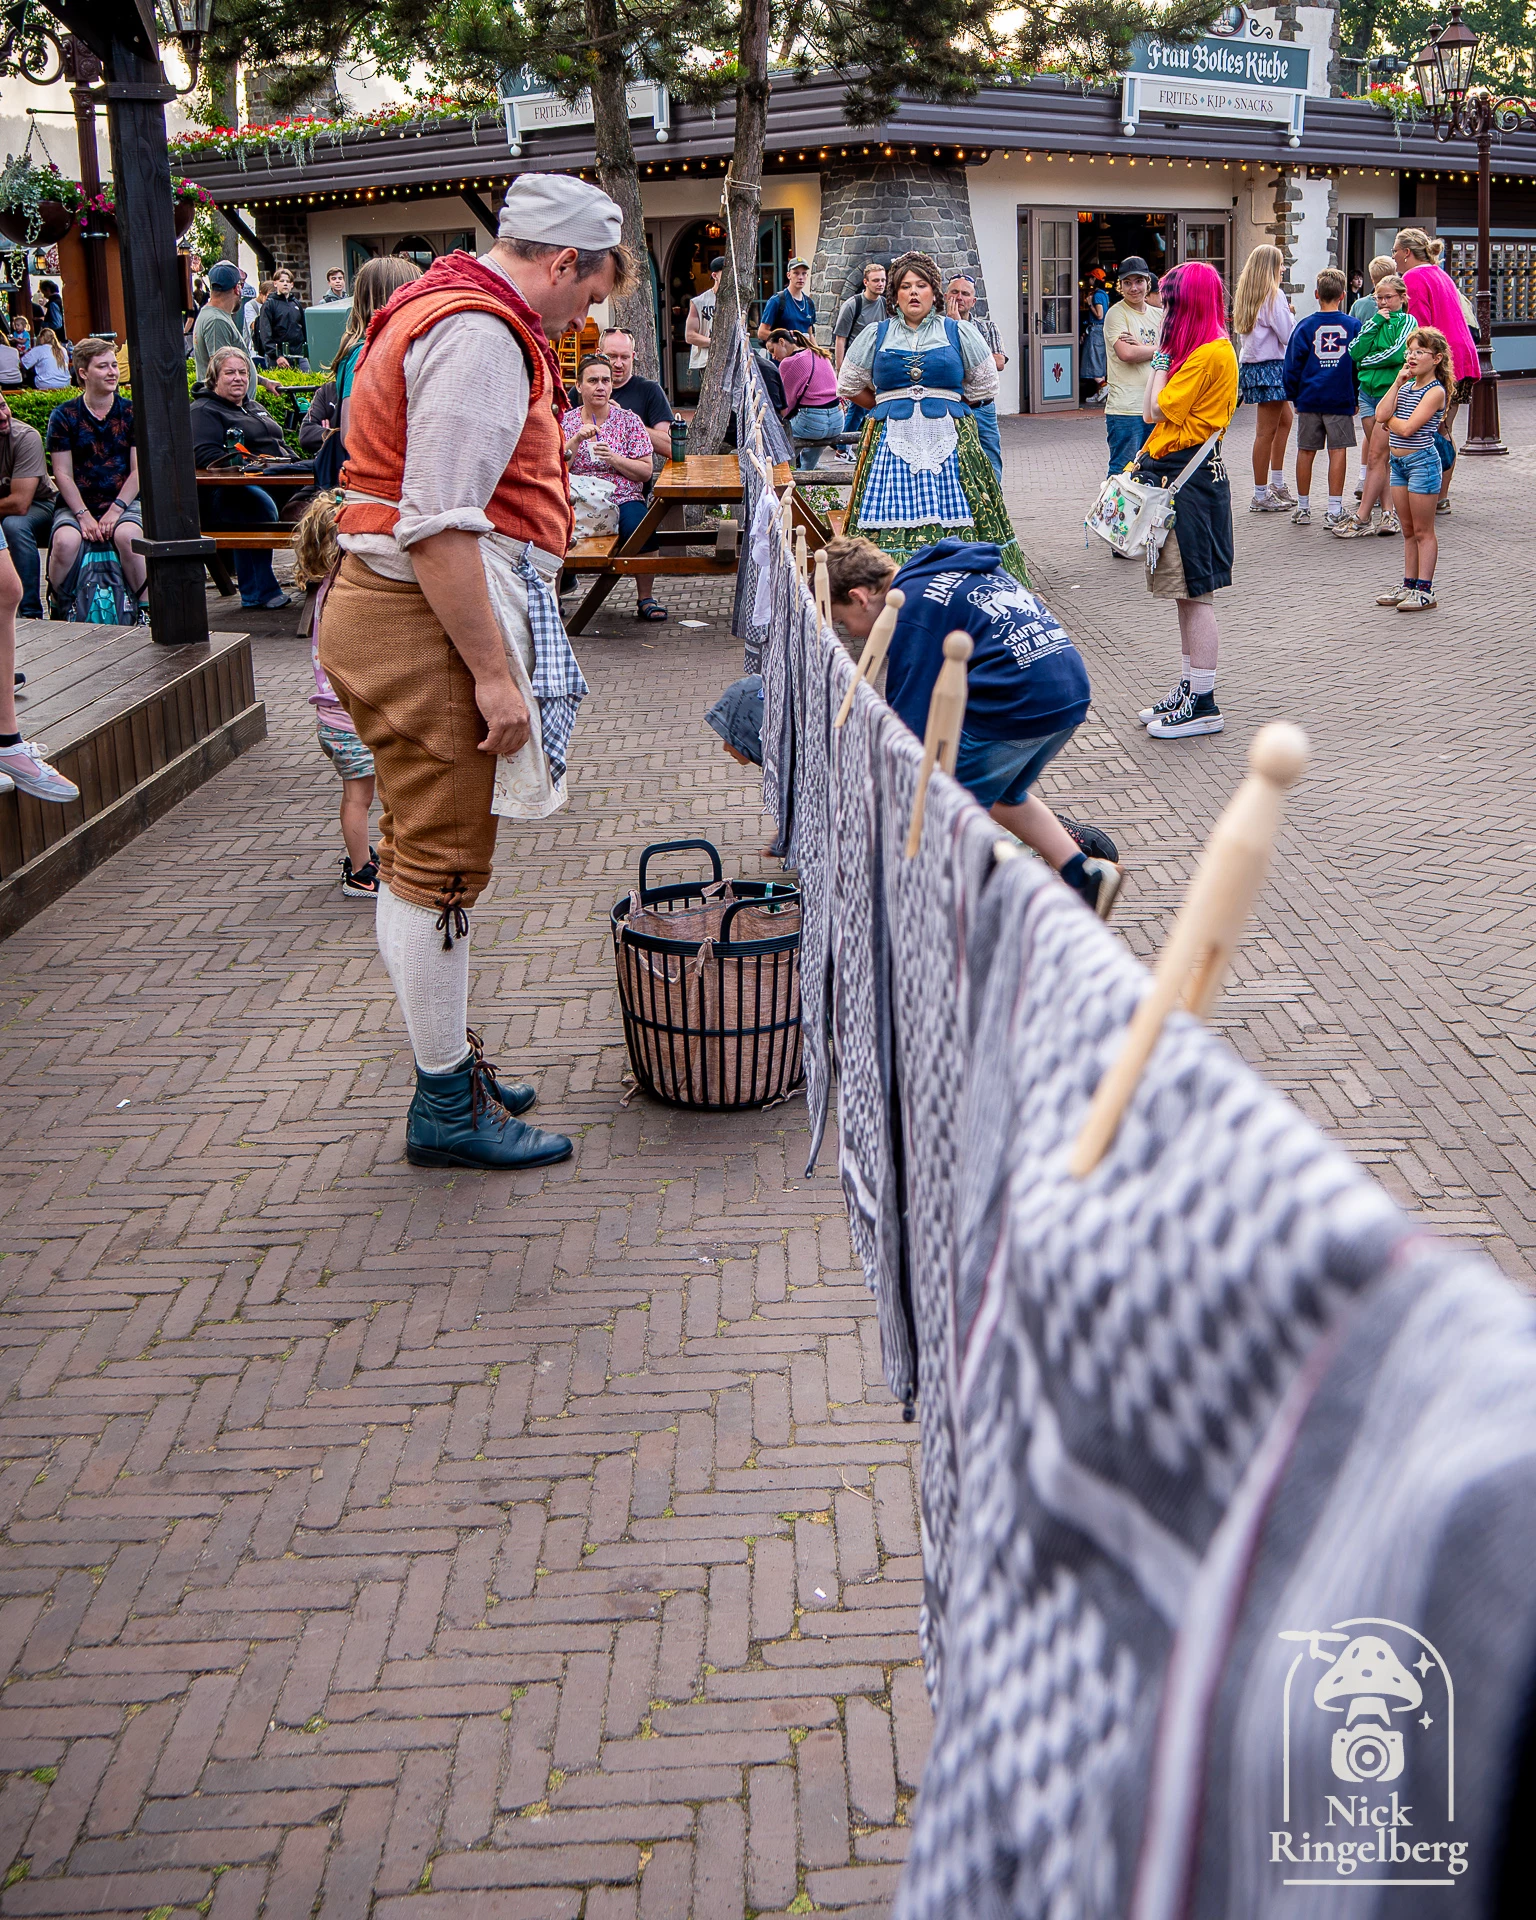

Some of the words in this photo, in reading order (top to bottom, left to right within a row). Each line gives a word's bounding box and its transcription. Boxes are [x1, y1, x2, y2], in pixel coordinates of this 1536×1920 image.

[1147, 40, 1189, 70] Frau
[1192, 44, 1244, 73] Boltes
[1245, 50, 1289, 83] Küche
[1160, 90, 1198, 107] FRITES
[1207, 94, 1226, 111] KIP
[1234, 97, 1273, 115] SNACKS
[534, 105, 567, 122] FRITES
[1011, 640, 1032, 657] JOY
